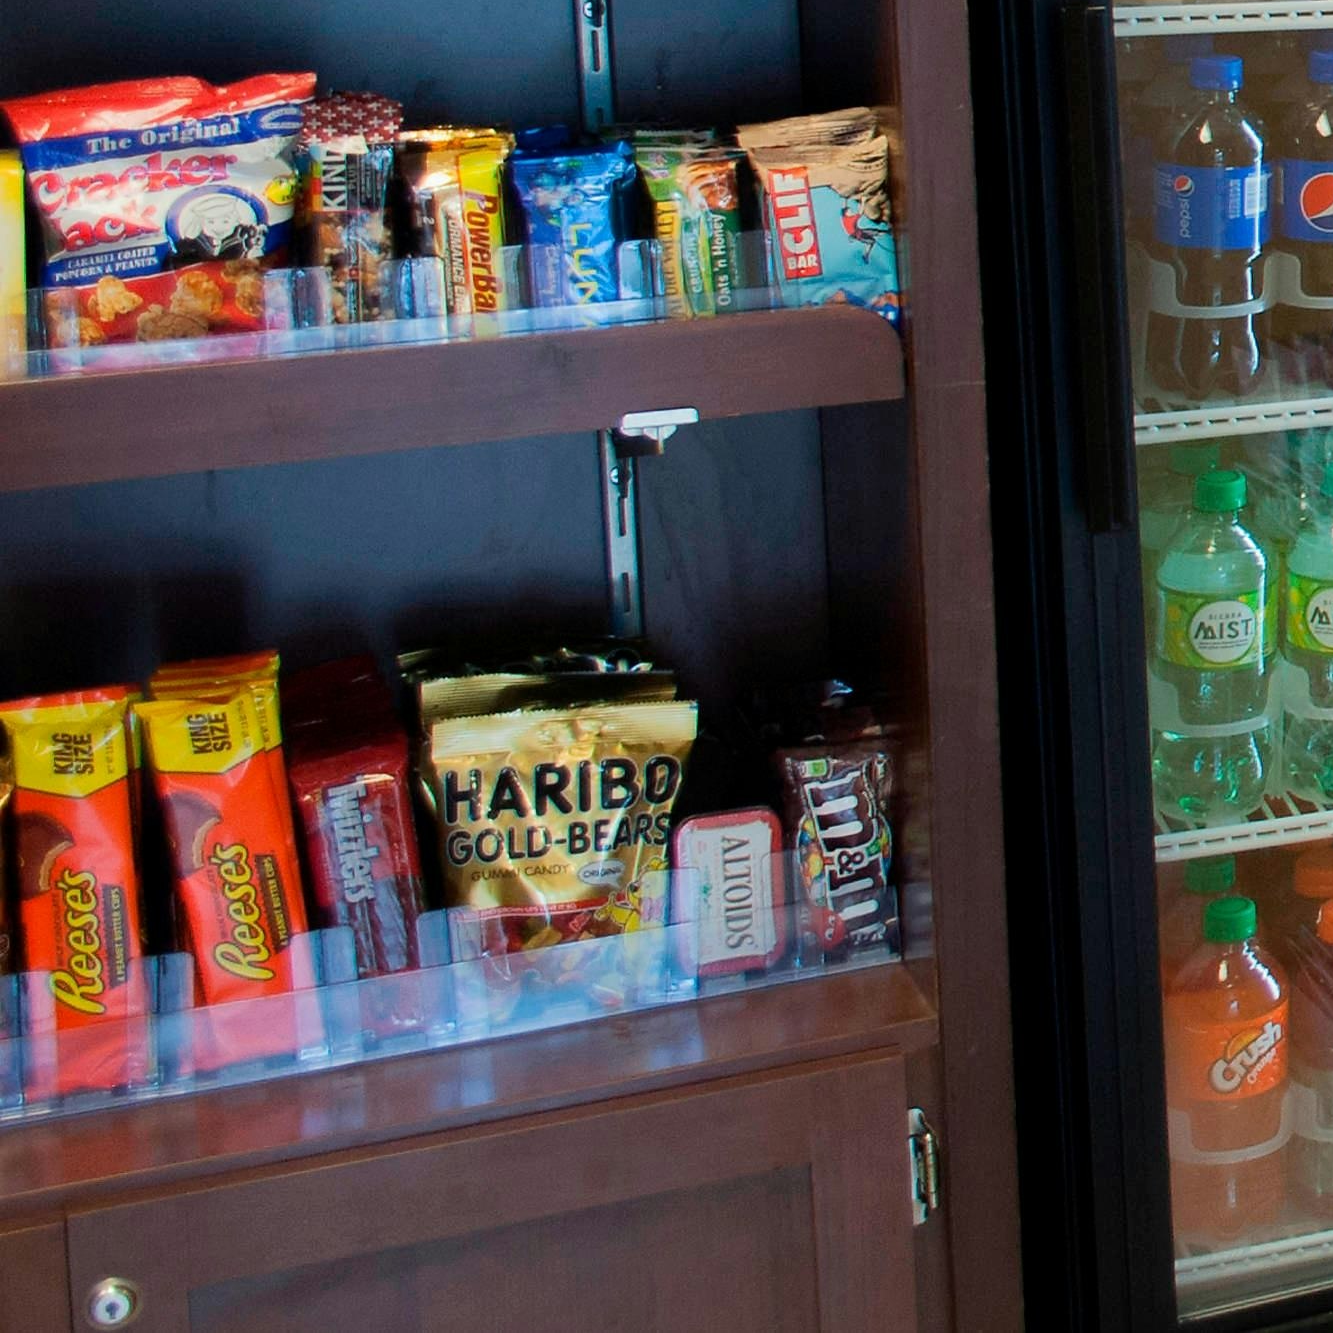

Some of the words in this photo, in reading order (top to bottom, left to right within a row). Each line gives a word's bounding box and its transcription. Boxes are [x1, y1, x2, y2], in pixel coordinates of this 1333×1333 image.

[86, 136, 132, 156] The
[140, 118, 242, 149] Original
[30, 151, 238, 215] Cracker
[772, 173, 816, 253] CLIF
[1178, 197, 1193, 238] pepsi
[116, 245, 157, 262] COATED
[711, 214, 728, 256] Honey
[54, 265, 103, 283] POPCORN
[113, 256, 159, 274] PEANUTS
[786, 253, 819, 270] BAR
[717, 273, 732, 307] Oats
[1194, 617, 1253, 639] MIST
[190, 711, 211, 755] KING
[211, 710, 232, 751] SIZE
[52, 731, 73, 776] KING
[73, 732, 95, 775] SIZE
[443, 754, 681, 825] HARIBO
[327, 775, 375, 904] Twizzlers
[447, 811, 671, 866] GOLD-BEARS
[524, 863, 569, 878] CANDY
[214, 842, 275, 982] Reese's
[721, 834, 755, 951] ALTOIDS
[50, 869, 106, 1014] Reese's
[1208, 1021, 1284, 1095] Crush
